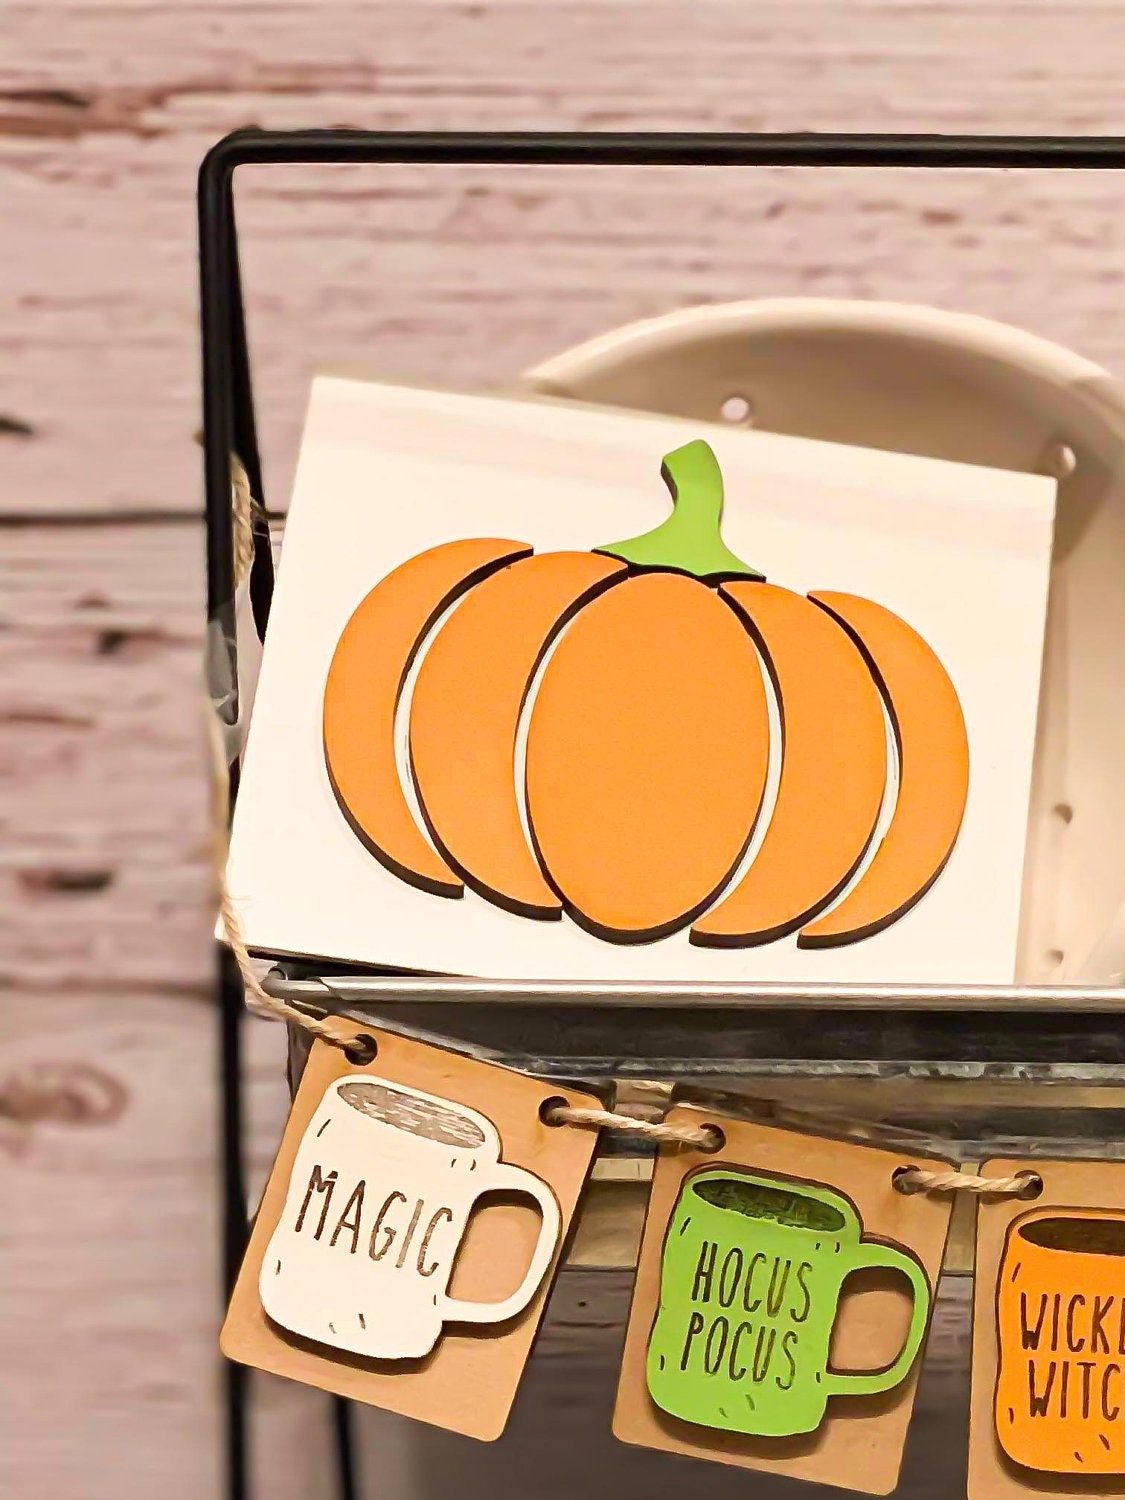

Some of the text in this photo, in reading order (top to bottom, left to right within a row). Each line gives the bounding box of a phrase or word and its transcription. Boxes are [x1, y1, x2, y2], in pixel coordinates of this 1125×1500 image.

[294, 1163, 454, 1277] MAGIC
[691, 1240, 814, 1323] HOCUS
[680, 1311, 799, 1391] POCUS
